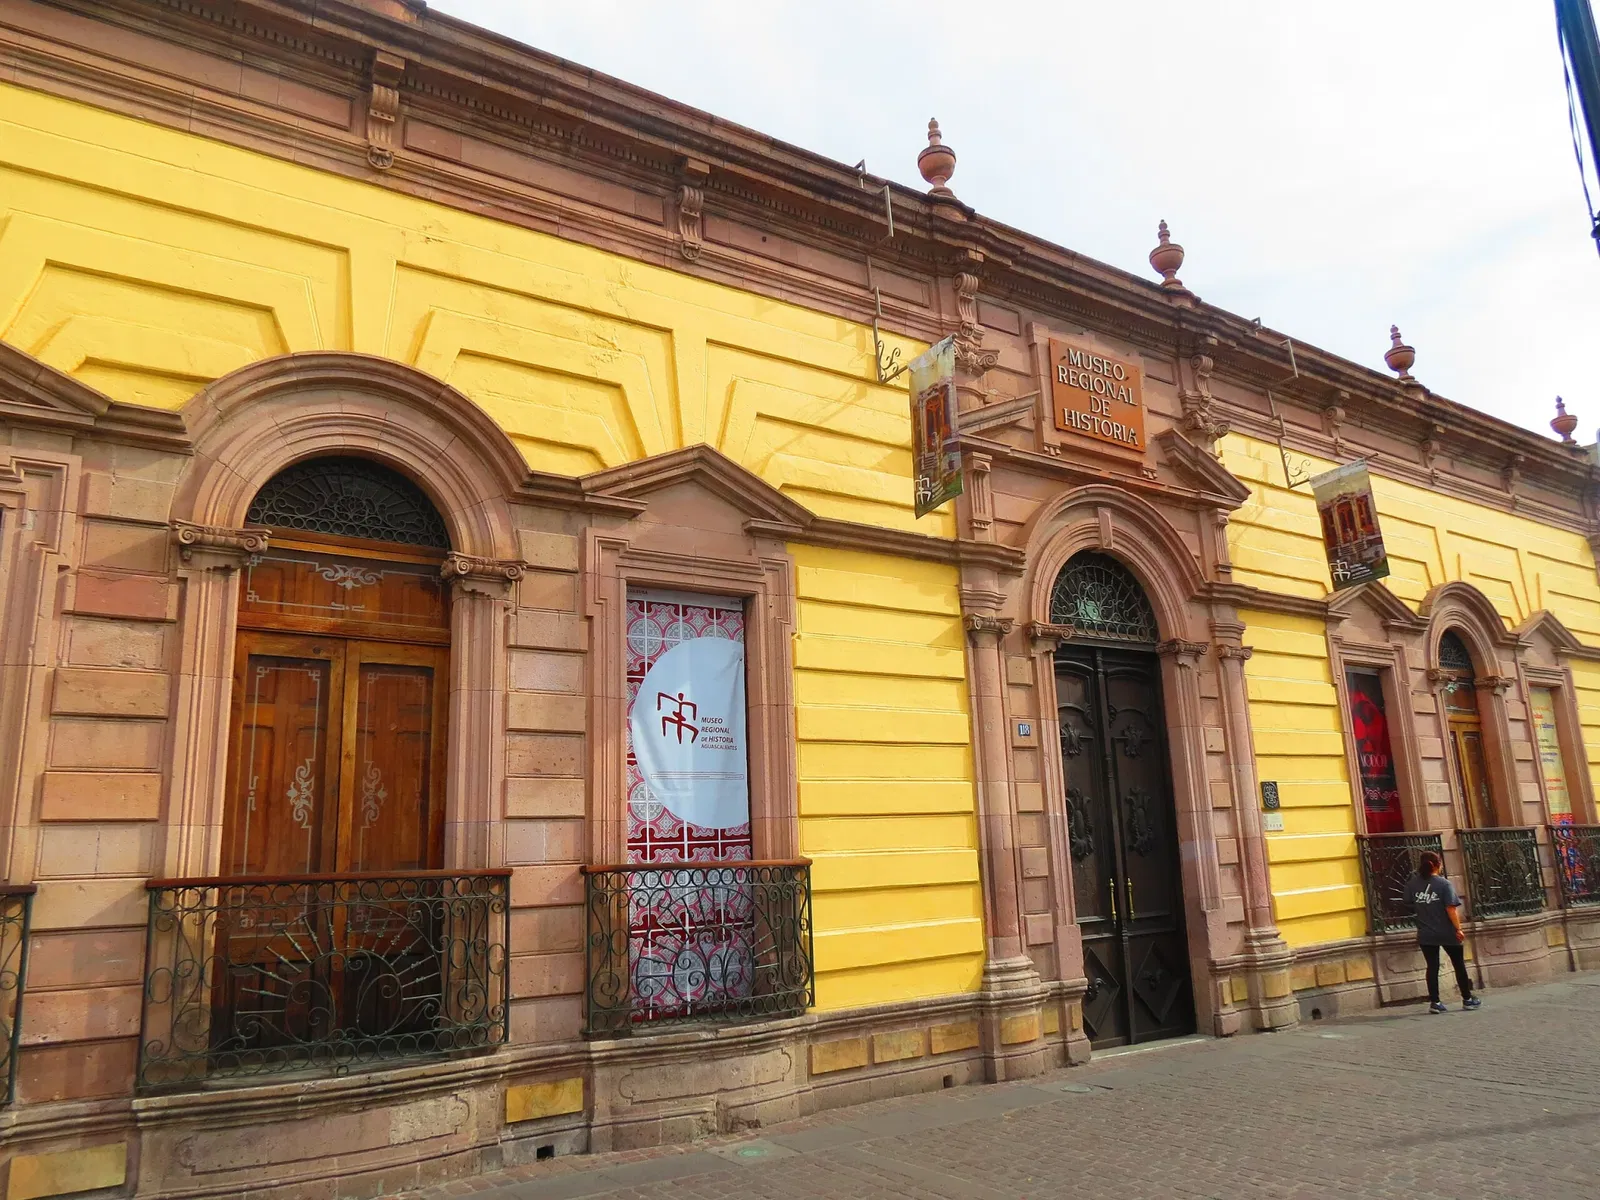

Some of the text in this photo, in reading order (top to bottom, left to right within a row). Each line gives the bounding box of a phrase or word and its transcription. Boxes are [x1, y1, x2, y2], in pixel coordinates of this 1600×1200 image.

[1068, 348, 1125, 381] MUSEO
[1057, 365, 1139, 406] REGIONAL
[1090, 395, 1112, 418] DE
[1063, 407, 1139, 446] HISTORIA
[701, 726, 730, 734] REGIONAL
